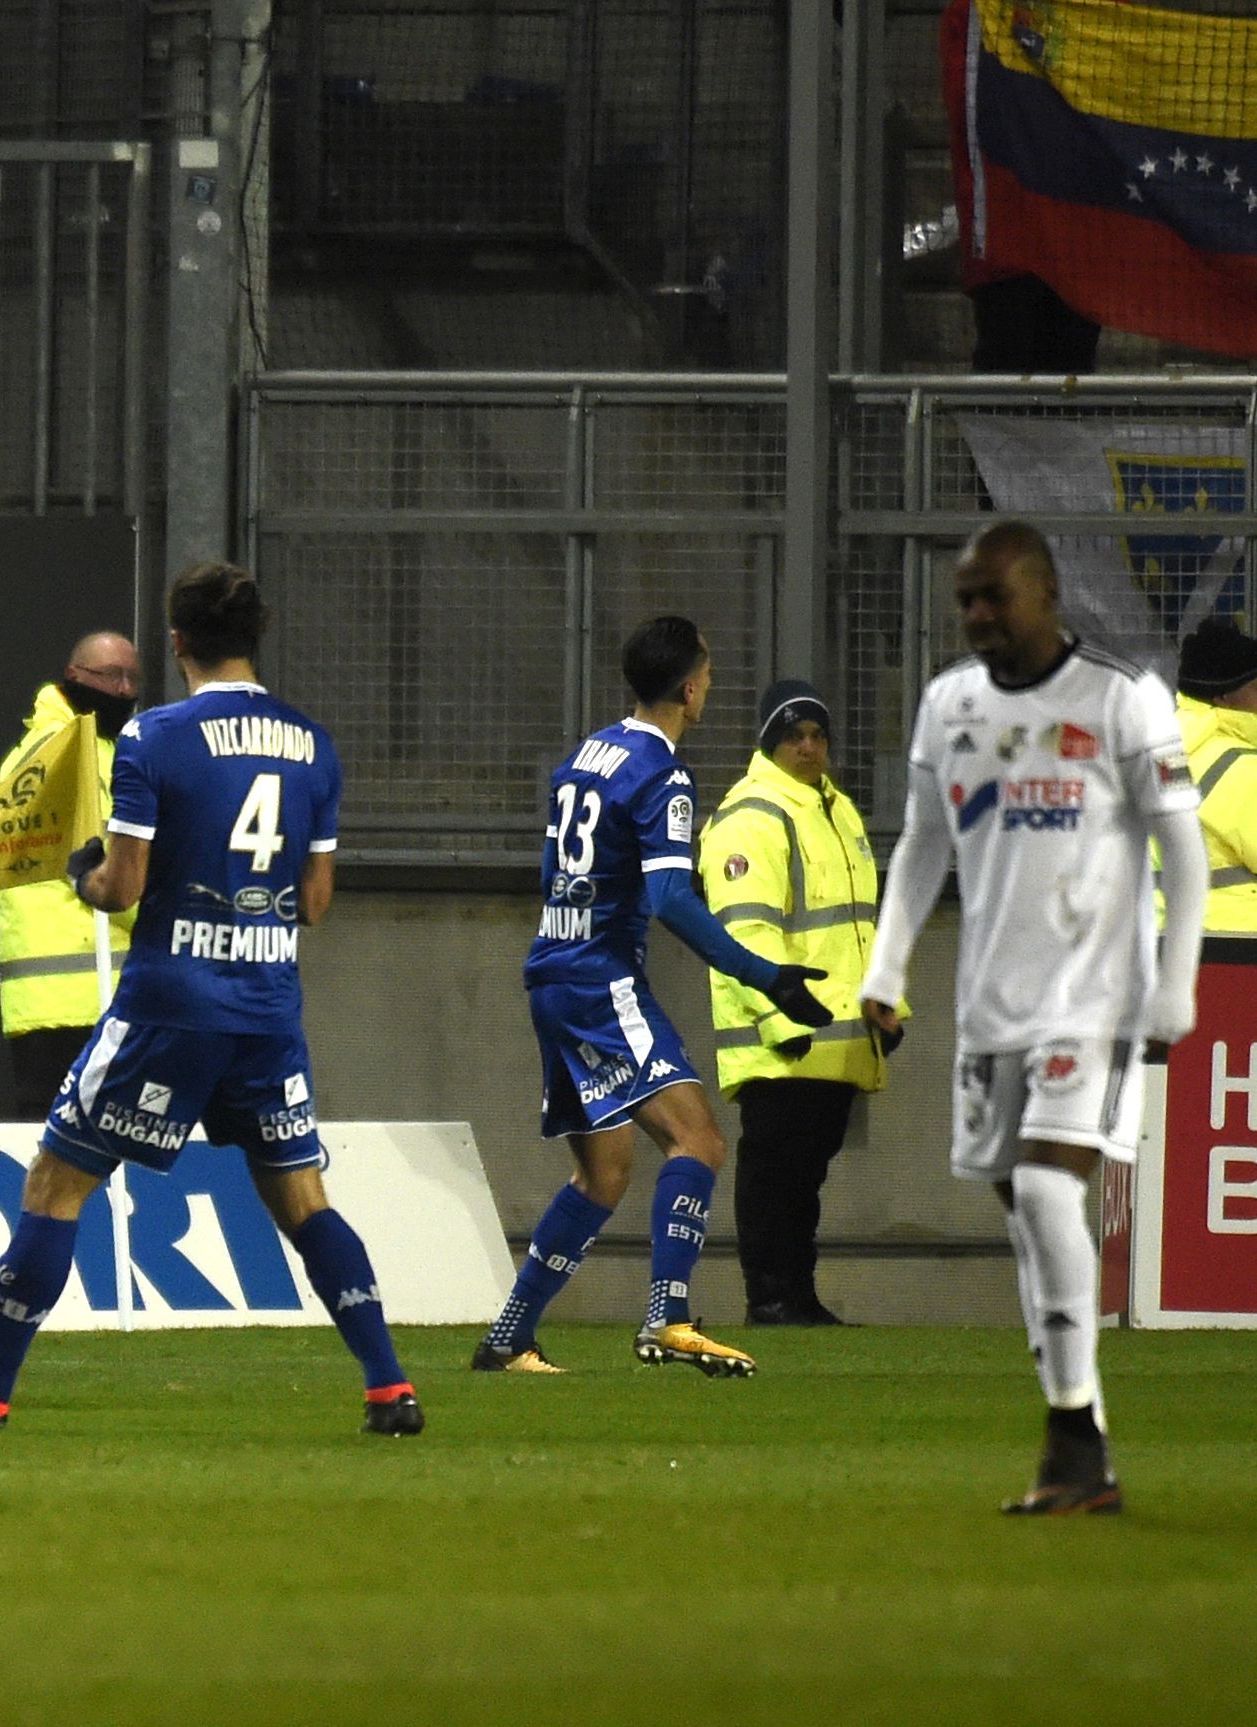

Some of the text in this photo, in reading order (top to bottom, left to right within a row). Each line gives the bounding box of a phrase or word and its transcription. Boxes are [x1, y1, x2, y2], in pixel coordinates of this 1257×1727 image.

[199, 715, 315, 765] VIZCARRONDO
[228, 773, 284, 874] 4
[557, 783, 602, 875] 13
[170, 918, 298, 963] PREMIUM
[98, 1114, 184, 1150] DUGAIN
